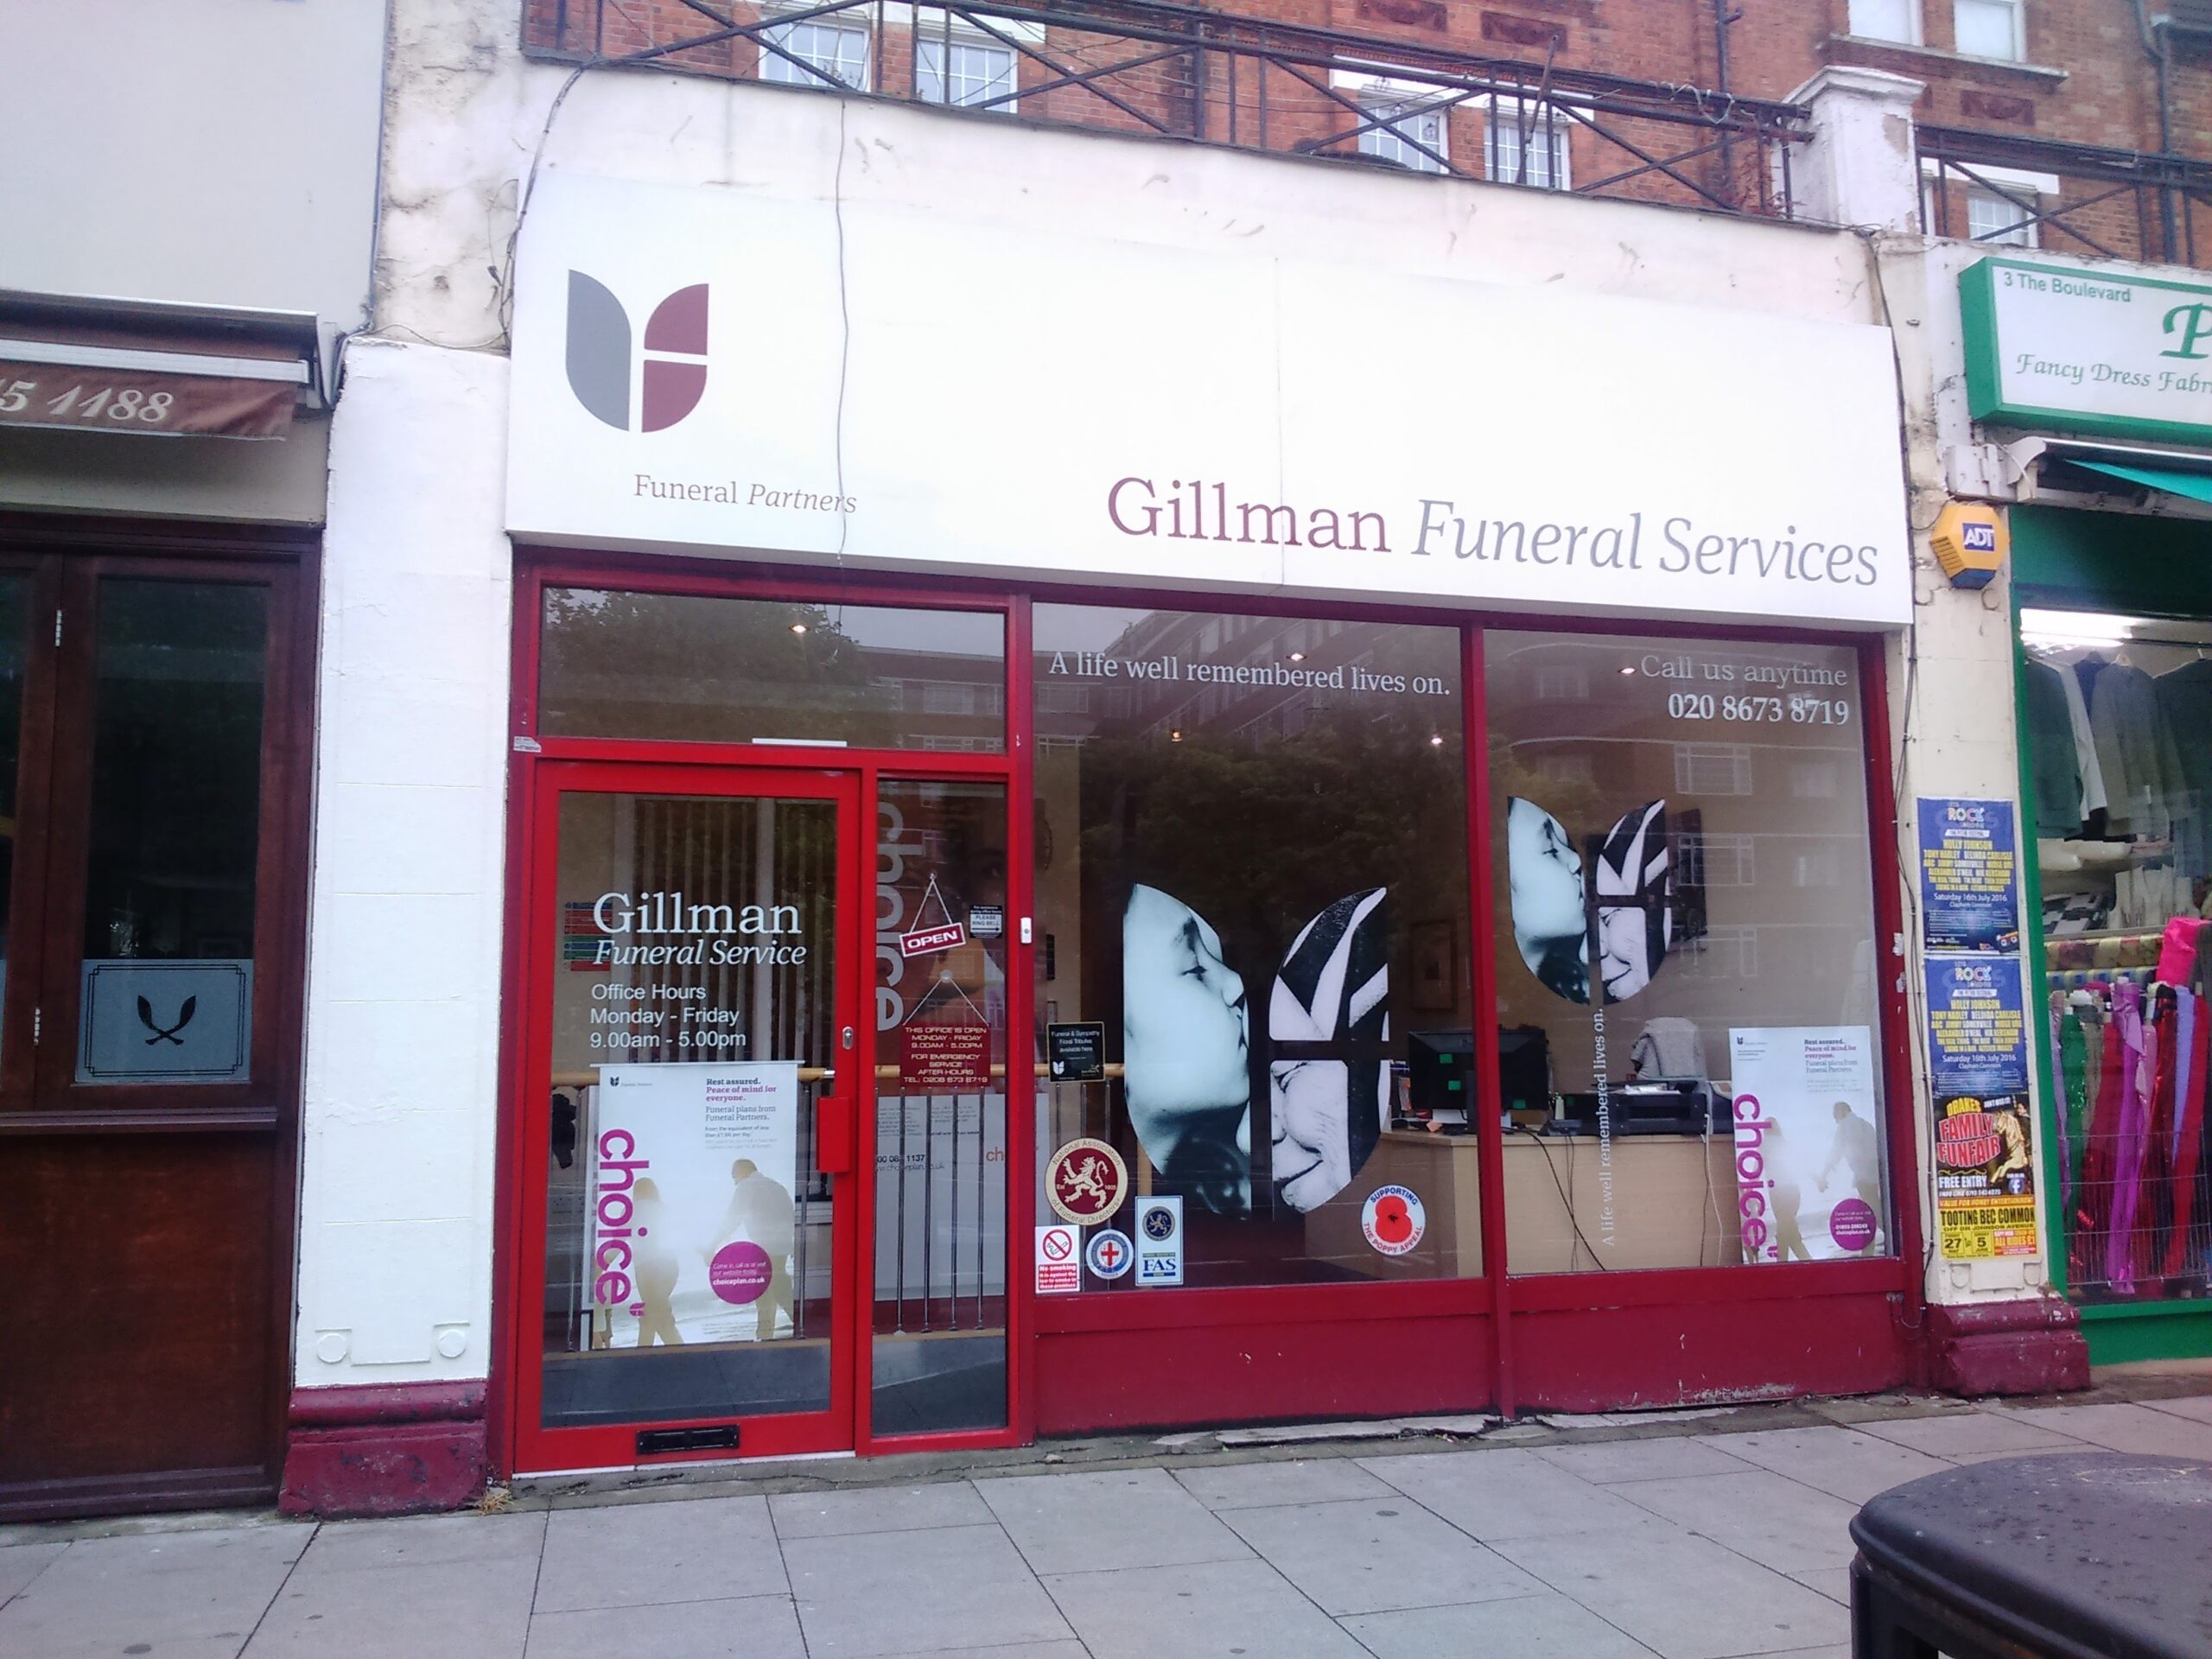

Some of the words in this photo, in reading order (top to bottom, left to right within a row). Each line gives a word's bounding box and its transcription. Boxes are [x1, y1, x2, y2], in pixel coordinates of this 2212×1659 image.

[2004, 271, 2013, 287] 3
[2018, 273, 2046, 291] The
[2052, 277, 2132, 302] Boulevard
[2016, 353, 2084, 385] Fancy
[2091, 364, 2152, 387] Dress
[47, 385, 174, 423] 1188
[634, 474, 739, 504] Funeral
[747, 483, 857, 513] Partners
[1108, 476, 1392, 553] Gillman
[1411, 499, 1643, 569] Funeral
[1659, 517, 1878, 586] Services
[1963, 524, 1994, 549] ADT
[1049, 652, 1069, 675] A
[1077, 652, 1118, 677] life
[1124, 656, 1179, 680] well
[1186, 662, 1344, 689] remembered
[1351, 666, 1406, 693] lives
[1413, 676, 1450, 696] on.
[1641, 655, 1694, 679] Call
[1701, 664, 1734, 681] us
[1744, 662, 1848, 690] anytime
[1668, 693, 1715, 720] 020
[1722, 695, 1783, 722] 8673
[1789, 696, 1849, 725] 8719
[1948, 808, 1985, 822] ROCK
[593, 891, 803, 934] Gillman
[592, 939, 703, 965] Funeral
[709, 939, 807, 965] Service
[907, 930, 958, 949] OPEN
[1955, 967, 1992, 981] ROCK
[591, 983, 645, 1001] Office
[652, 983, 707, 1001] Hours
[590, 1007, 665, 1027] Monday
[683, 1007, 740, 1027] Friday
[1593, 1008, 1604, 1032] on.
[590, 1032, 660, 1048] 9.00am
[678, 1031, 747, 1050] 5.00pm
[1593, 1036, 1606, 1069] lives
[1942, 1054, 1970, 1063] Saturday
[1593, 1073, 1611, 1166] remembered
[1946, 1097, 1982, 1118] DRAKES
[1939, 1113, 1993, 1141] FAMILY
[906, 1154, 925, 1162] 1137
[1052, 1141, 1079, 1166] National
[1082, 1140, 1122, 1166] Association
[1936, 1135, 2000, 1167] FUNFAIR
[1734, 1094, 1775, 1247] choice
[1939, 1176, 1961, 1189] FREE
[1961, 1175, 1987, 1188] ENTRY
[1370, 1187, 1418, 1205] SUPPORTING
[1599, 1172, 1612, 1202] well
[595, 1129, 650, 1305] choice
[1058, 1207, 1085, 1223] Funeral
[1601, 1206, 1613, 1230] life
[1940, 1210, 1978, 1226] TOOTING
[1980, 1208, 1996, 1224] BEC
[1999, 1206, 2035, 1224] COMMON
[1364, 1221, 1374, 1239] THE
[1372, 1239, 1397, 1252] POPPY
[1401, 1226, 1422, 1251] APPEAL
[1602, 1236, 1614, 1246] A
[1944, 1238, 1961, 1249] 27
[1977, 1237, 1986, 1247] 5
[1143, 1258, 1177, 1271] FAS
[713, 1277, 766, 1287] choiceplan.co.uk
